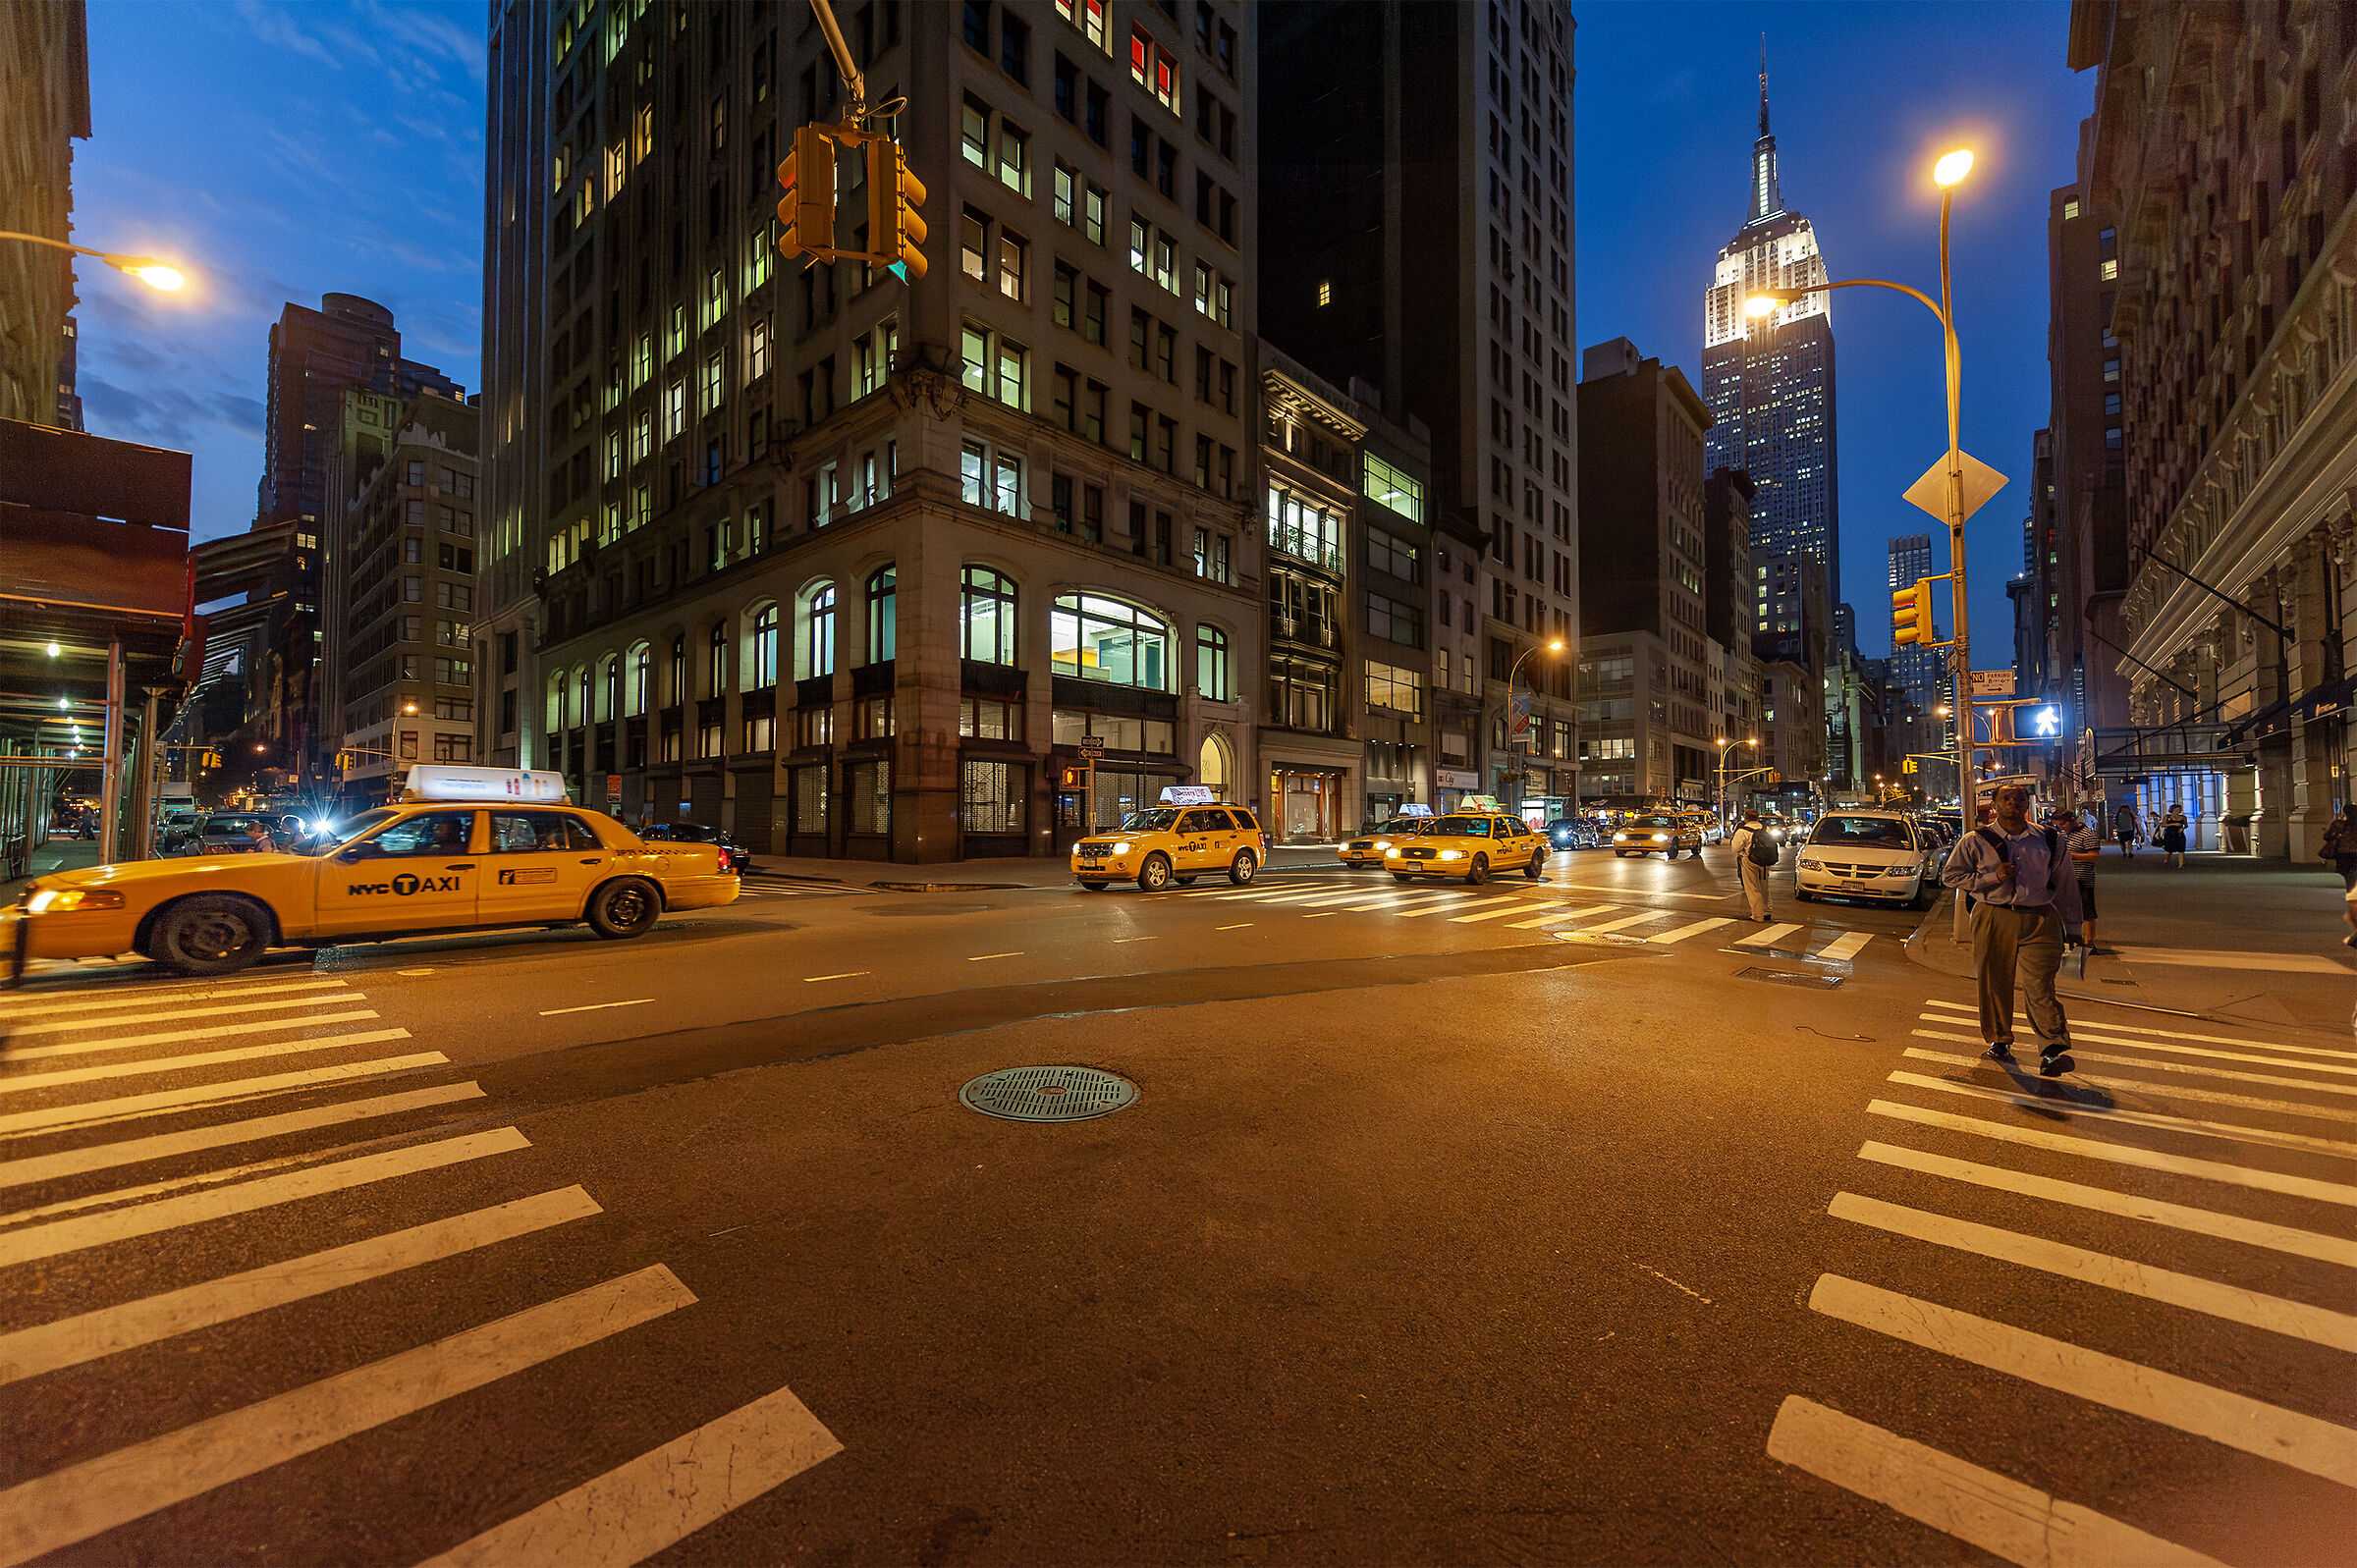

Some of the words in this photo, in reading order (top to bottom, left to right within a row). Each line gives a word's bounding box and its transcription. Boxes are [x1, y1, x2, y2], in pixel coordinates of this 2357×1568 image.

[1972, 673, 1984, 682] NO
[1188, 840, 1207, 852] TAXI
[349, 883, 390, 895] NYC
[393, 873, 461, 896] TAXI
